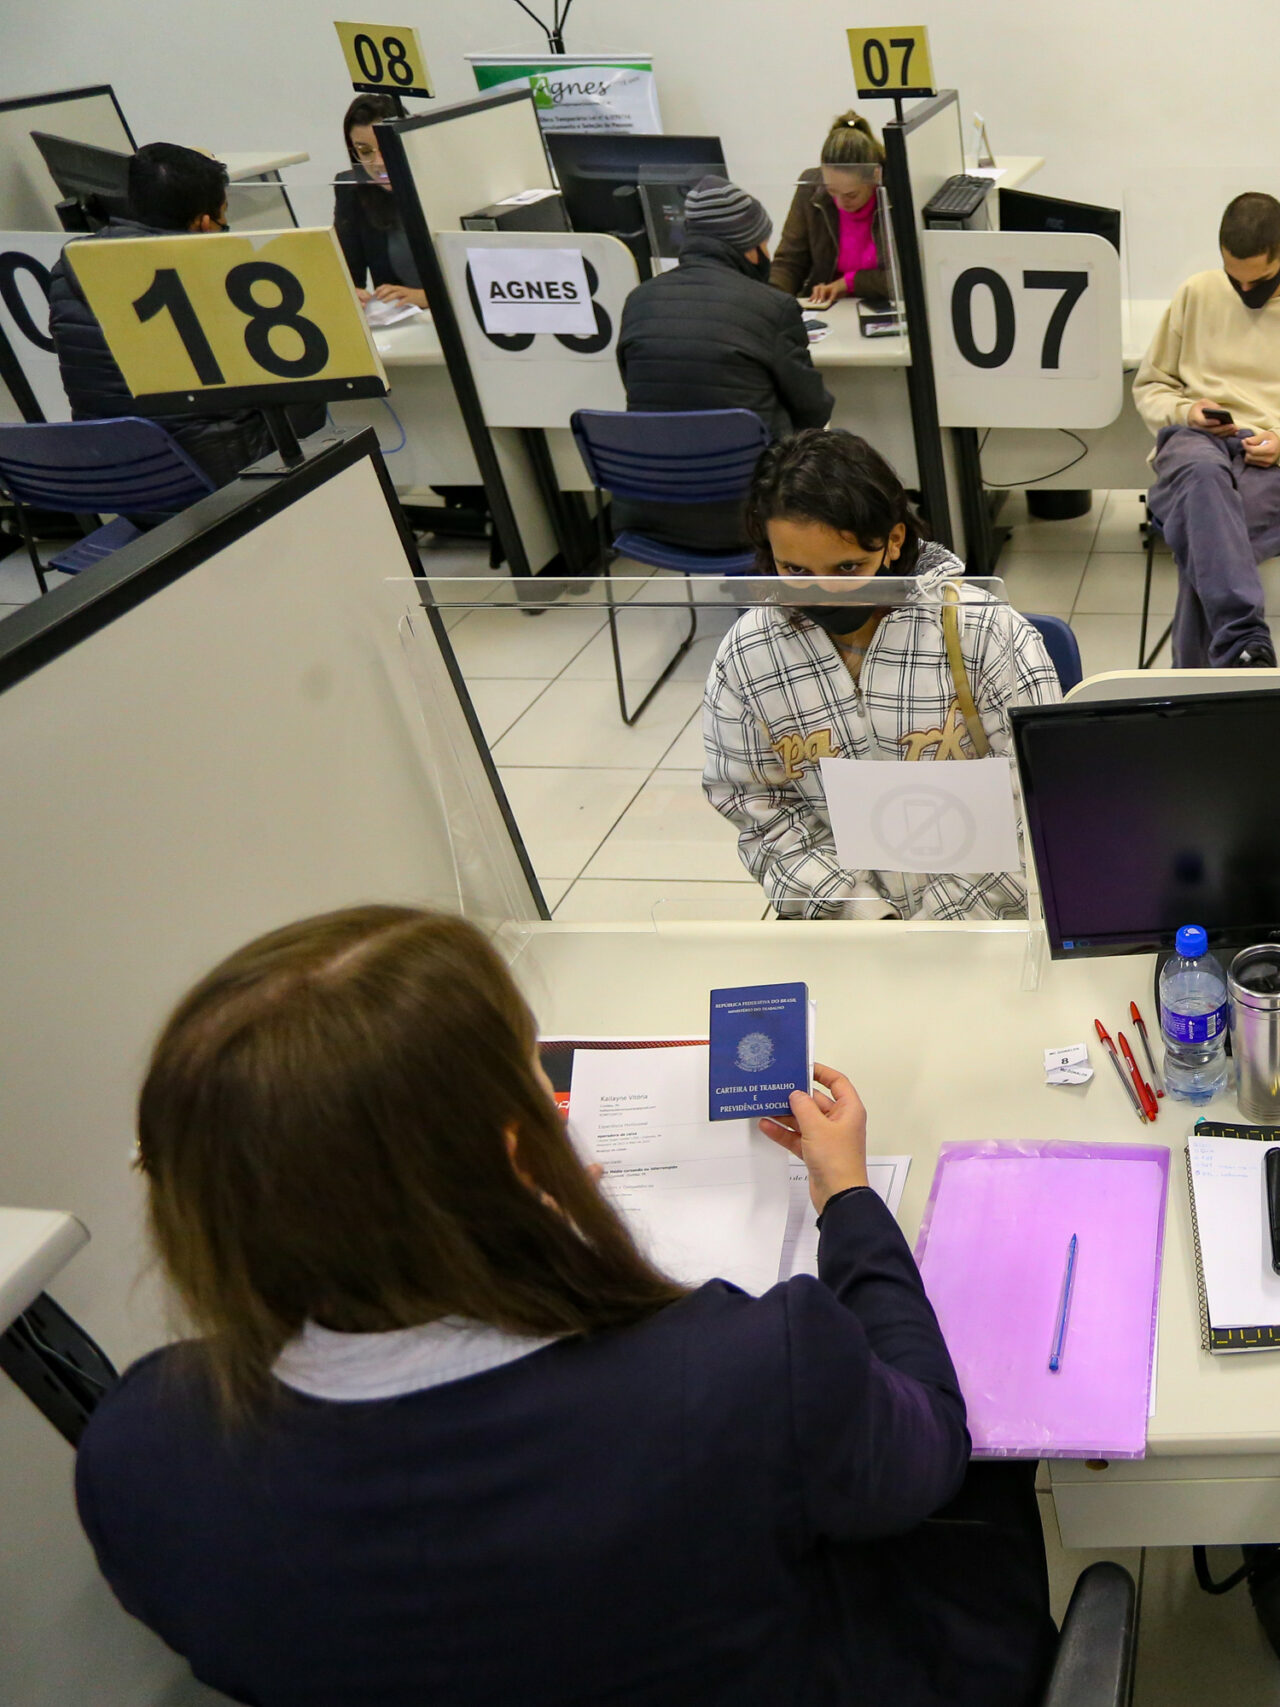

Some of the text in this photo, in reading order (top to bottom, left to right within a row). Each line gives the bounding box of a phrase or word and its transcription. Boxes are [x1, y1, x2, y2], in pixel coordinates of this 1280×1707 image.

[353, 34, 414, 87] 08
[863, 38, 915, 87] 07
[489, 281, 578, 300] AGNES
[132, 261, 329, 386] 18
[951, 266, 1089, 369] 07
[715, 1086, 748, 1095] CARTEIRA
[760, 1083, 795, 1091] TRABALHO
[720, 1101, 789, 1112] PREVIDÊNCIA SOCIAL
